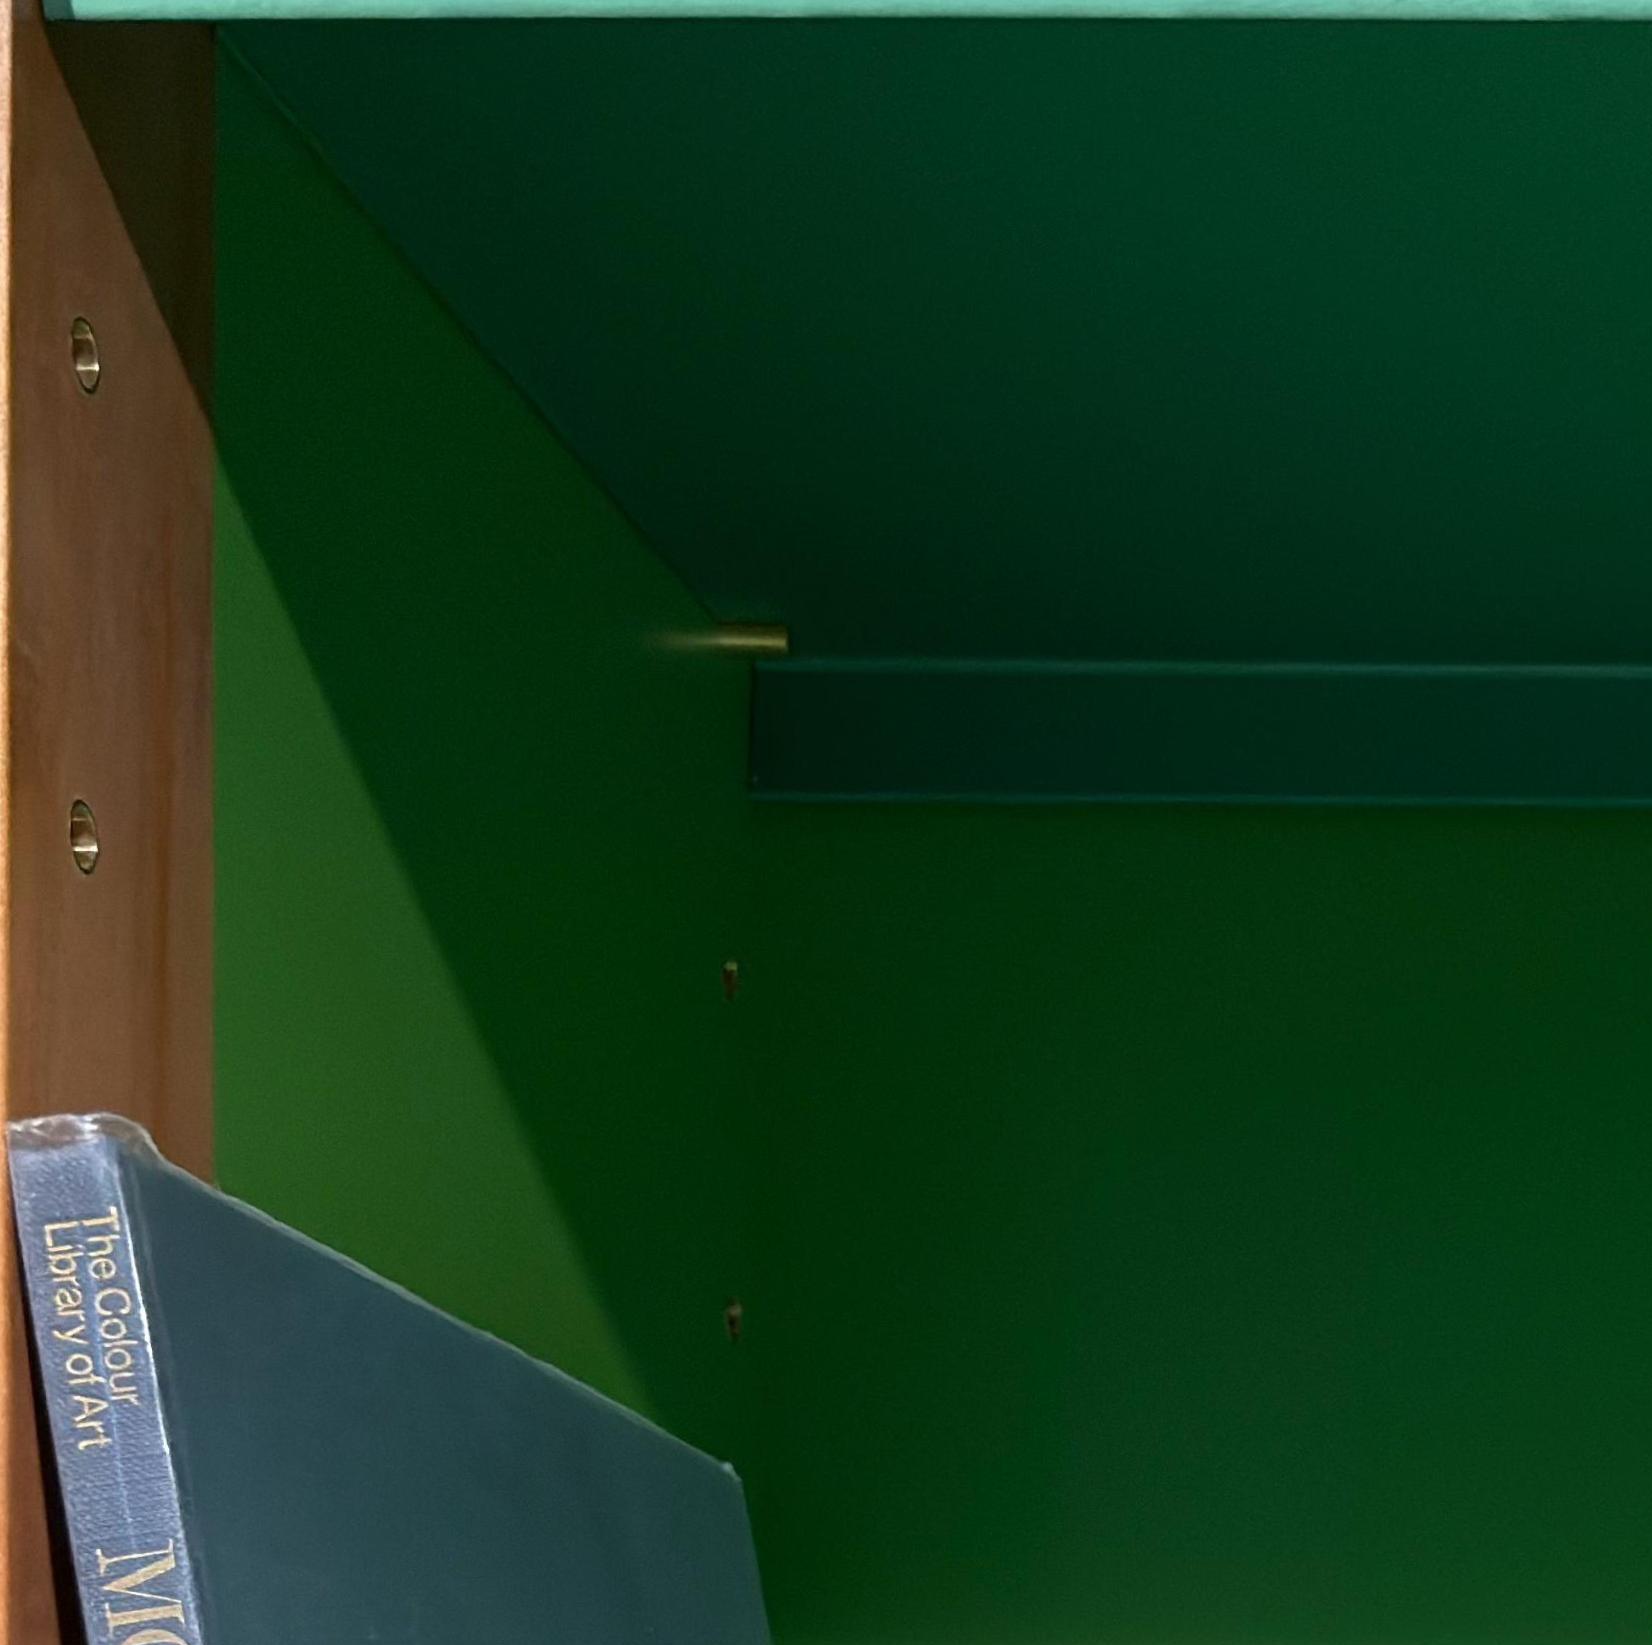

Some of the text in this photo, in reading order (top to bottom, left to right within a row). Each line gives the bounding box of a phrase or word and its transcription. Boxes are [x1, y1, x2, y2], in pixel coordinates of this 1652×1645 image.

[43, 1220, 111, 1450] Library of Art
[82, 1207, 140, 1407] The Colour
